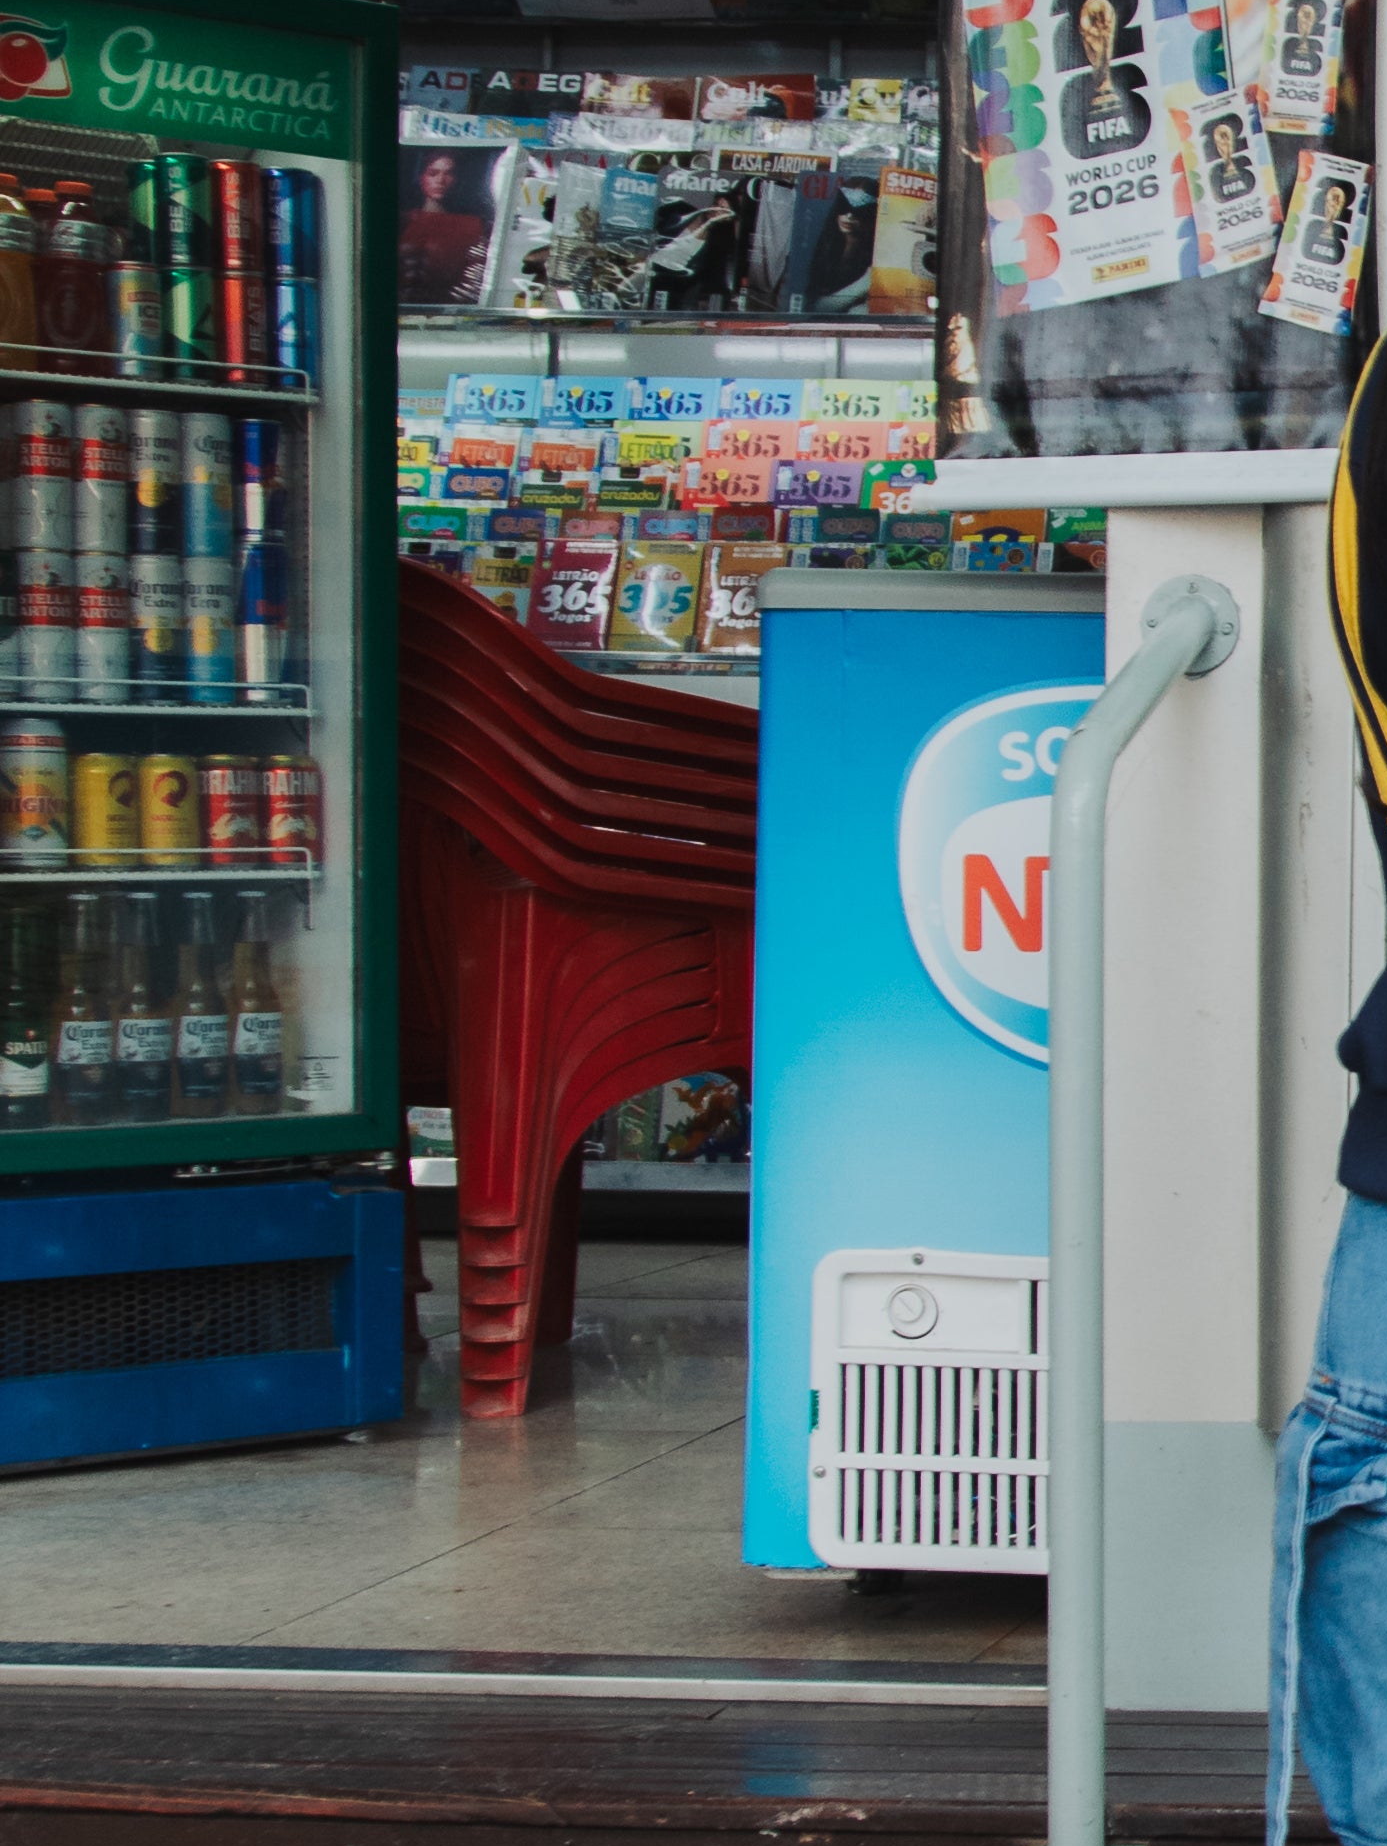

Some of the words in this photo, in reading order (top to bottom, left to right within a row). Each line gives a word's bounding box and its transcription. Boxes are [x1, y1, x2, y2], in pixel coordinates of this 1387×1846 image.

[100, 25, 338, 113] Guaraná
[1275, 87, 1320, 103] 2026
[148, 96, 332, 141] ANTARCTICA
[1086, 116, 1133, 144] FIFA
[731, 153, 763, 172] CASA
[770, 156, 818, 173] JARDIM
[1064, 162, 1123, 187] WORLD
[1125, 154, 1158, 172] CUP
[167, 164, 185, 234] BEATS
[1067, 173, 1160, 216] 2026
[1221, 180, 1248, 196] FIFA
[226, 171, 242, 240] BEATS
[1217, 207, 1264, 232] 2026
[1311, 243, 1336, 258] FIFA
[1290, 272, 1339, 294] 2026
[551, 567, 601, 582] LETRÃO
[537, 581, 612, 615] 365
[548, 611, 593, 625] Jogos
